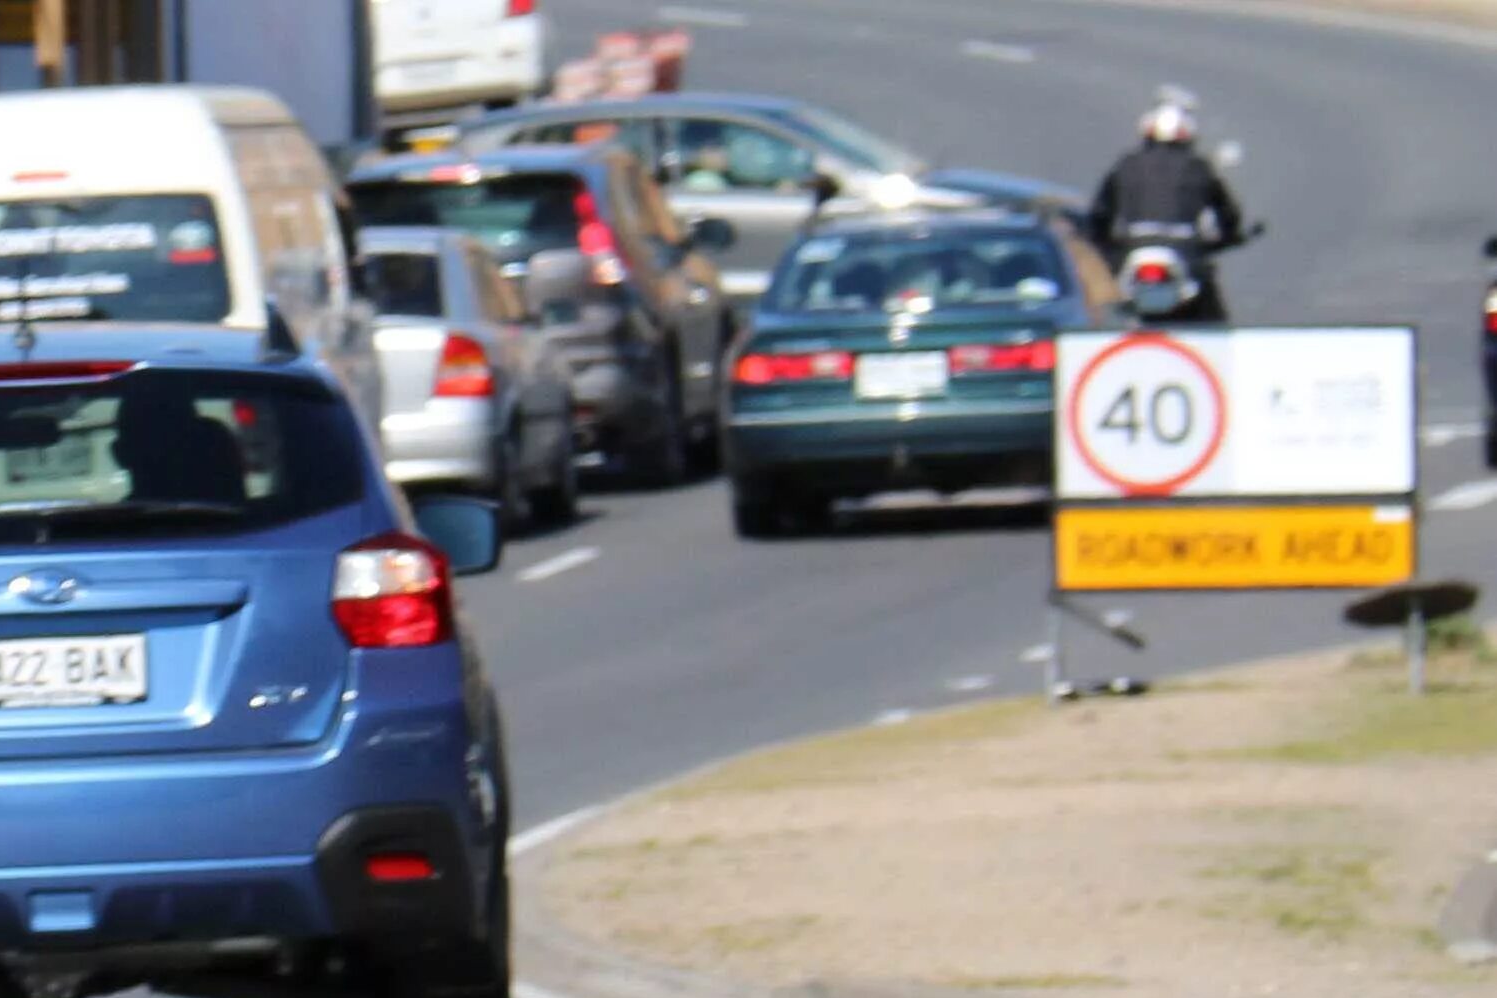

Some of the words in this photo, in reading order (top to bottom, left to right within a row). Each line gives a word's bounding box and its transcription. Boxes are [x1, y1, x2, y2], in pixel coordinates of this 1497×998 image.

[1097, 384, 1193, 446] 40
[1075, 530, 1259, 570] ROADWORK
[1279, 527, 1396, 568] AHEAD
